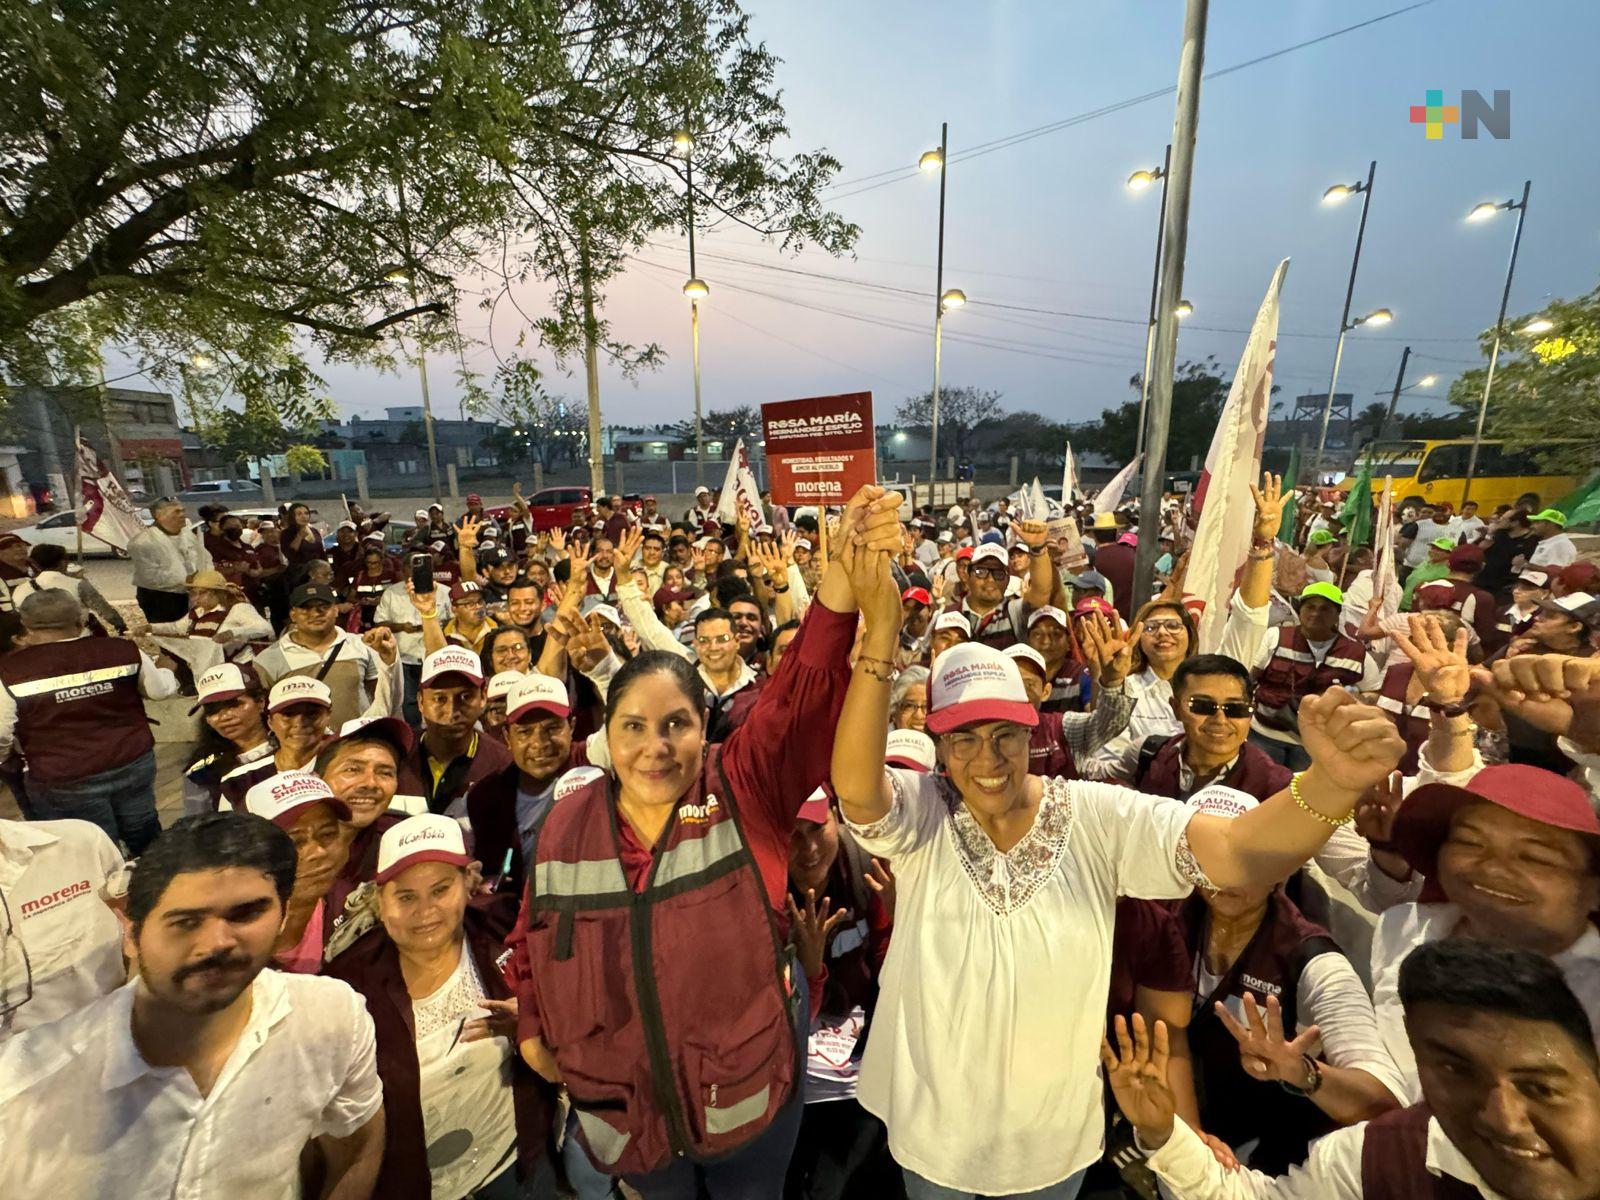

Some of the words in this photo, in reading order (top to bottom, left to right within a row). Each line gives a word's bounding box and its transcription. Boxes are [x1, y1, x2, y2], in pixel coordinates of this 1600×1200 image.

[768, 418, 808, 430] ROSA
[810, 411, 862, 426] MARÍA
[769, 426, 824, 436] HERNÁNDEZ
[825, 422, 863, 431] ESPEJO
[795, 480, 842, 492] morena
[55, 681, 114, 700] morena
[1191, 797, 1247, 812] CLAUDIA
[21, 879, 92, 914] morena
